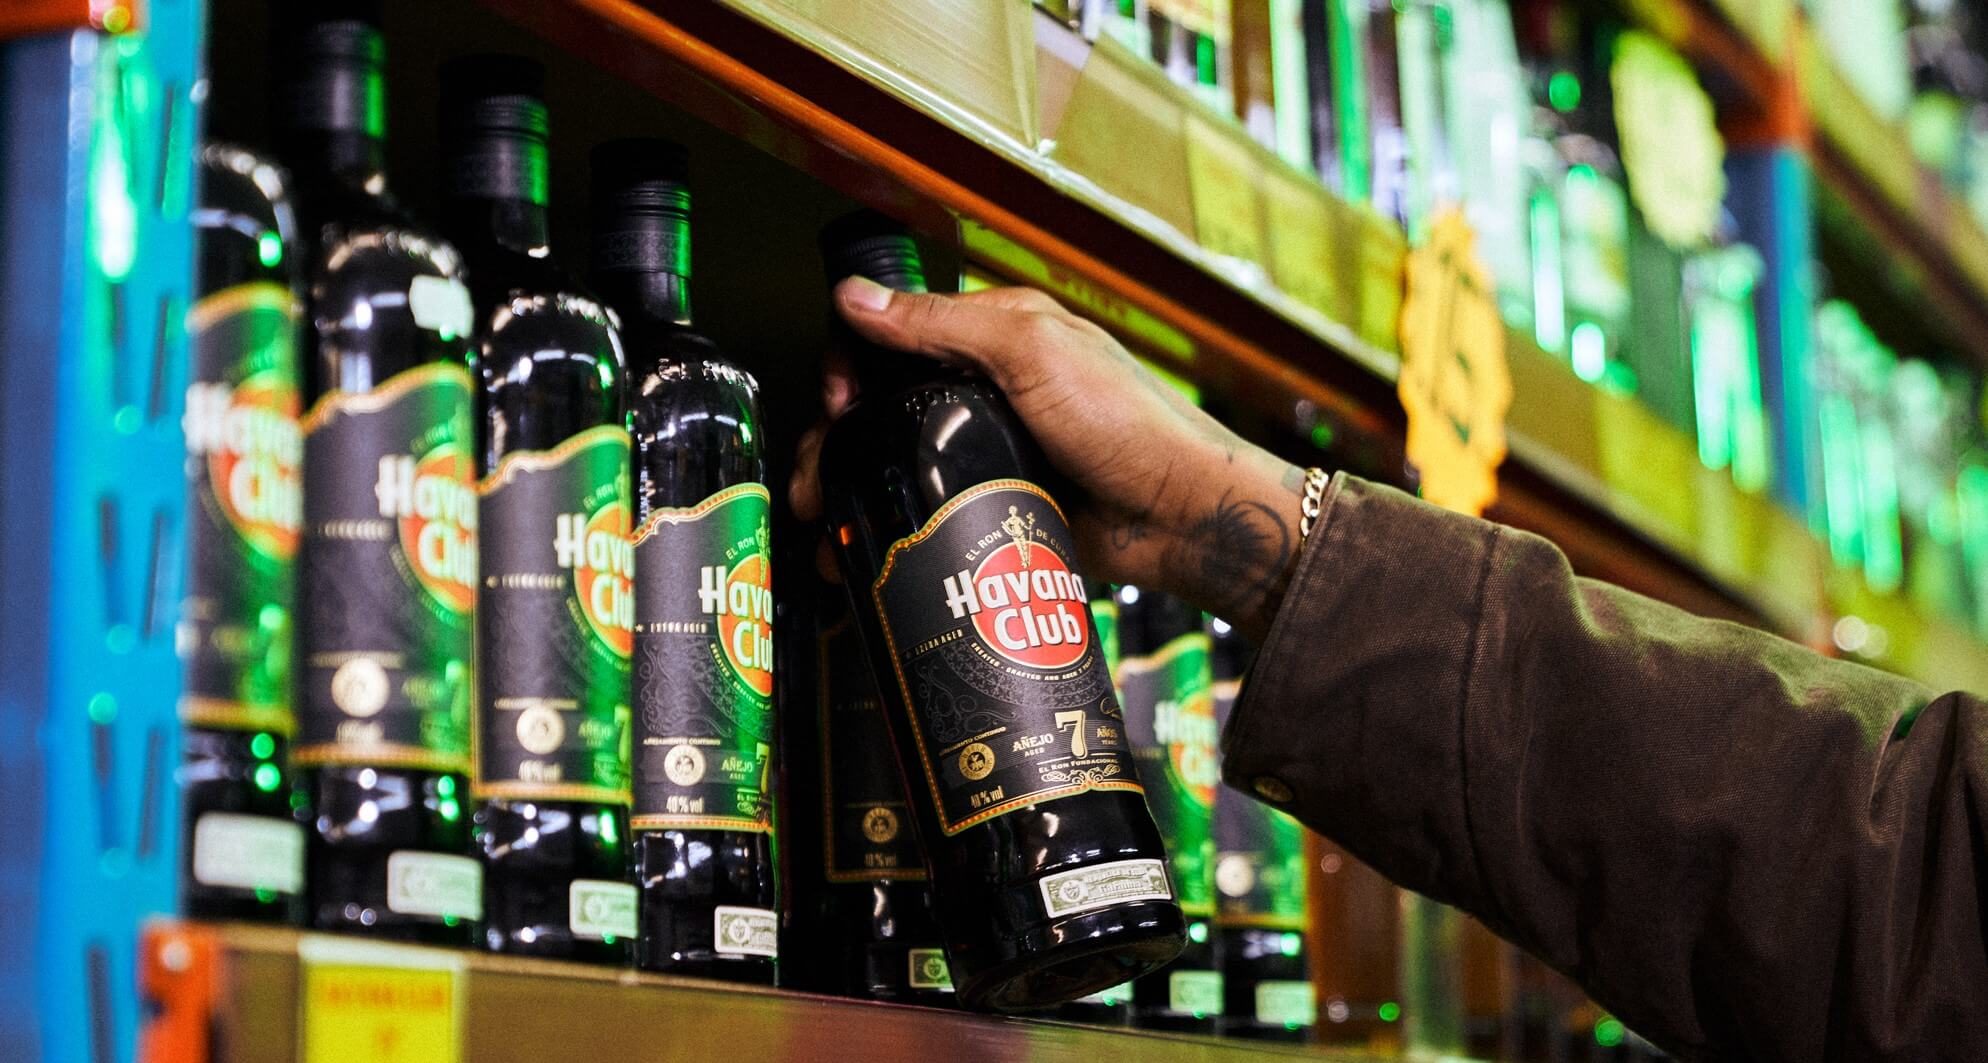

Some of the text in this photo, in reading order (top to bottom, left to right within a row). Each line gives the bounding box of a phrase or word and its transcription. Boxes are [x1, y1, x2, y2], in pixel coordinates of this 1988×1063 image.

[725, 536, 755, 561] EL RON
[965, 547, 981, 561] EL
[977, 529, 1003, 549] RON
[1036, 528, 1048, 541] DE
[943, 567, 1087, 619] Havana
[993, 603, 1083, 651] Club
[1012, 732, 1055, 753] AÑEJO
[1054, 710, 1088, 760] 7
[1024, 746, 1045, 758] AGED
[721, 742, 770, 794] AÑEJO 7
[1038, 766, 1050, 774] EL
[1051, 762, 1070, 772] RON
[689, 796, 704, 813] vol
[989, 784, 1005, 802] vol
